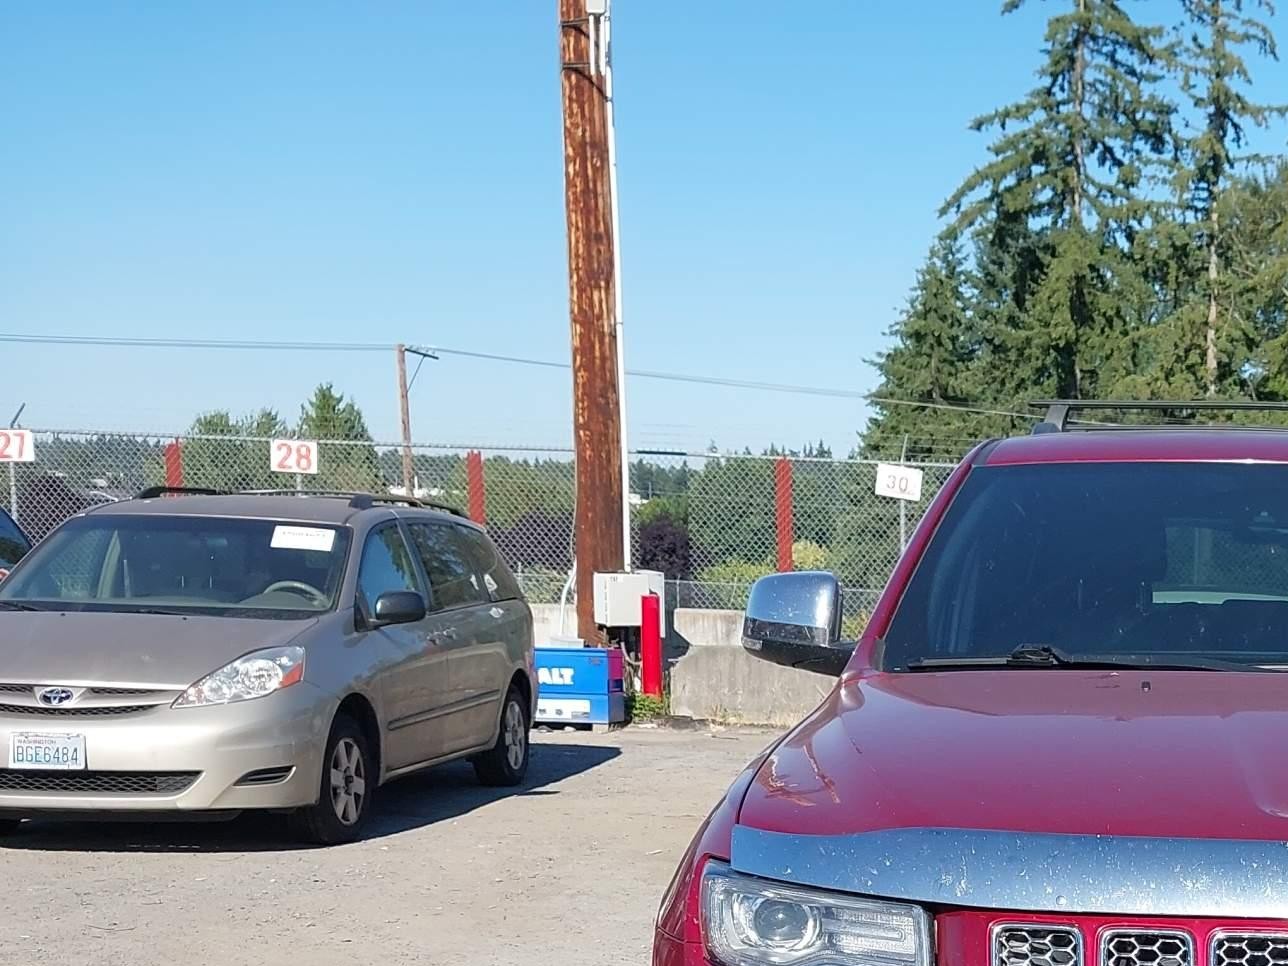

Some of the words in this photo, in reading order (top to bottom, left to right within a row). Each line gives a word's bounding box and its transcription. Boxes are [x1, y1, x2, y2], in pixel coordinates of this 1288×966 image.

[0, 432, 25, 459] 27
[277, 443, 312, 471] 28
[886, 474, 909, 493] 30
[16, 745, 79, 764] BGE6484
